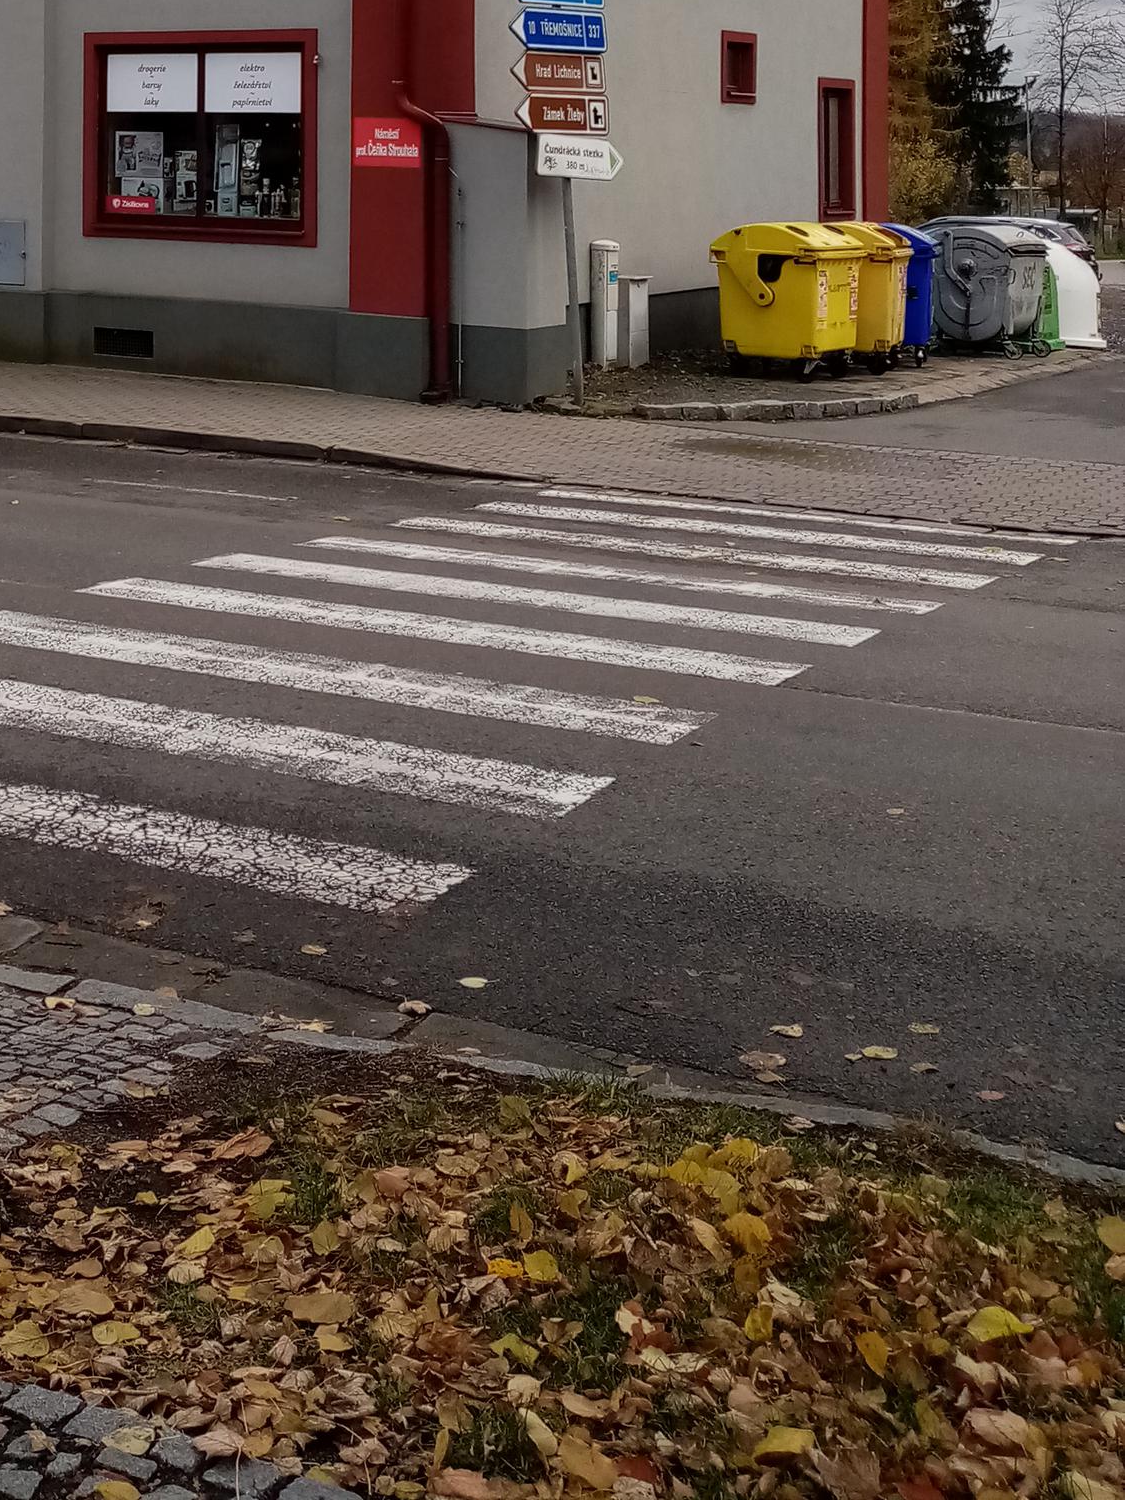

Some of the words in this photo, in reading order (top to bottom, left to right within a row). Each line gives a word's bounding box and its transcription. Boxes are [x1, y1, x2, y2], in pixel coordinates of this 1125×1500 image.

[528, 20, 536, 35] 10
[540, 18, 583, 37] TŘEMOŠNICE
[588, 24, 600, 38] 337
[137, 64, 167, 74] drogerie
[240, 64, 265, 72] elektro
[535, 63, 552, 78] Hrad
[554, 64, 582, 79] Lichnice
[233, 80, 271, 89] železářství
[144, 97, 159, 107] laky
[232, 97, 273, 108] papírnictví
[542, 106, 566, 121] Zámek
[567, 104, 585, 125] Žleby
[544, 143, 581, 157] Čundrácká
[583, 147, 603, 158] stezka
